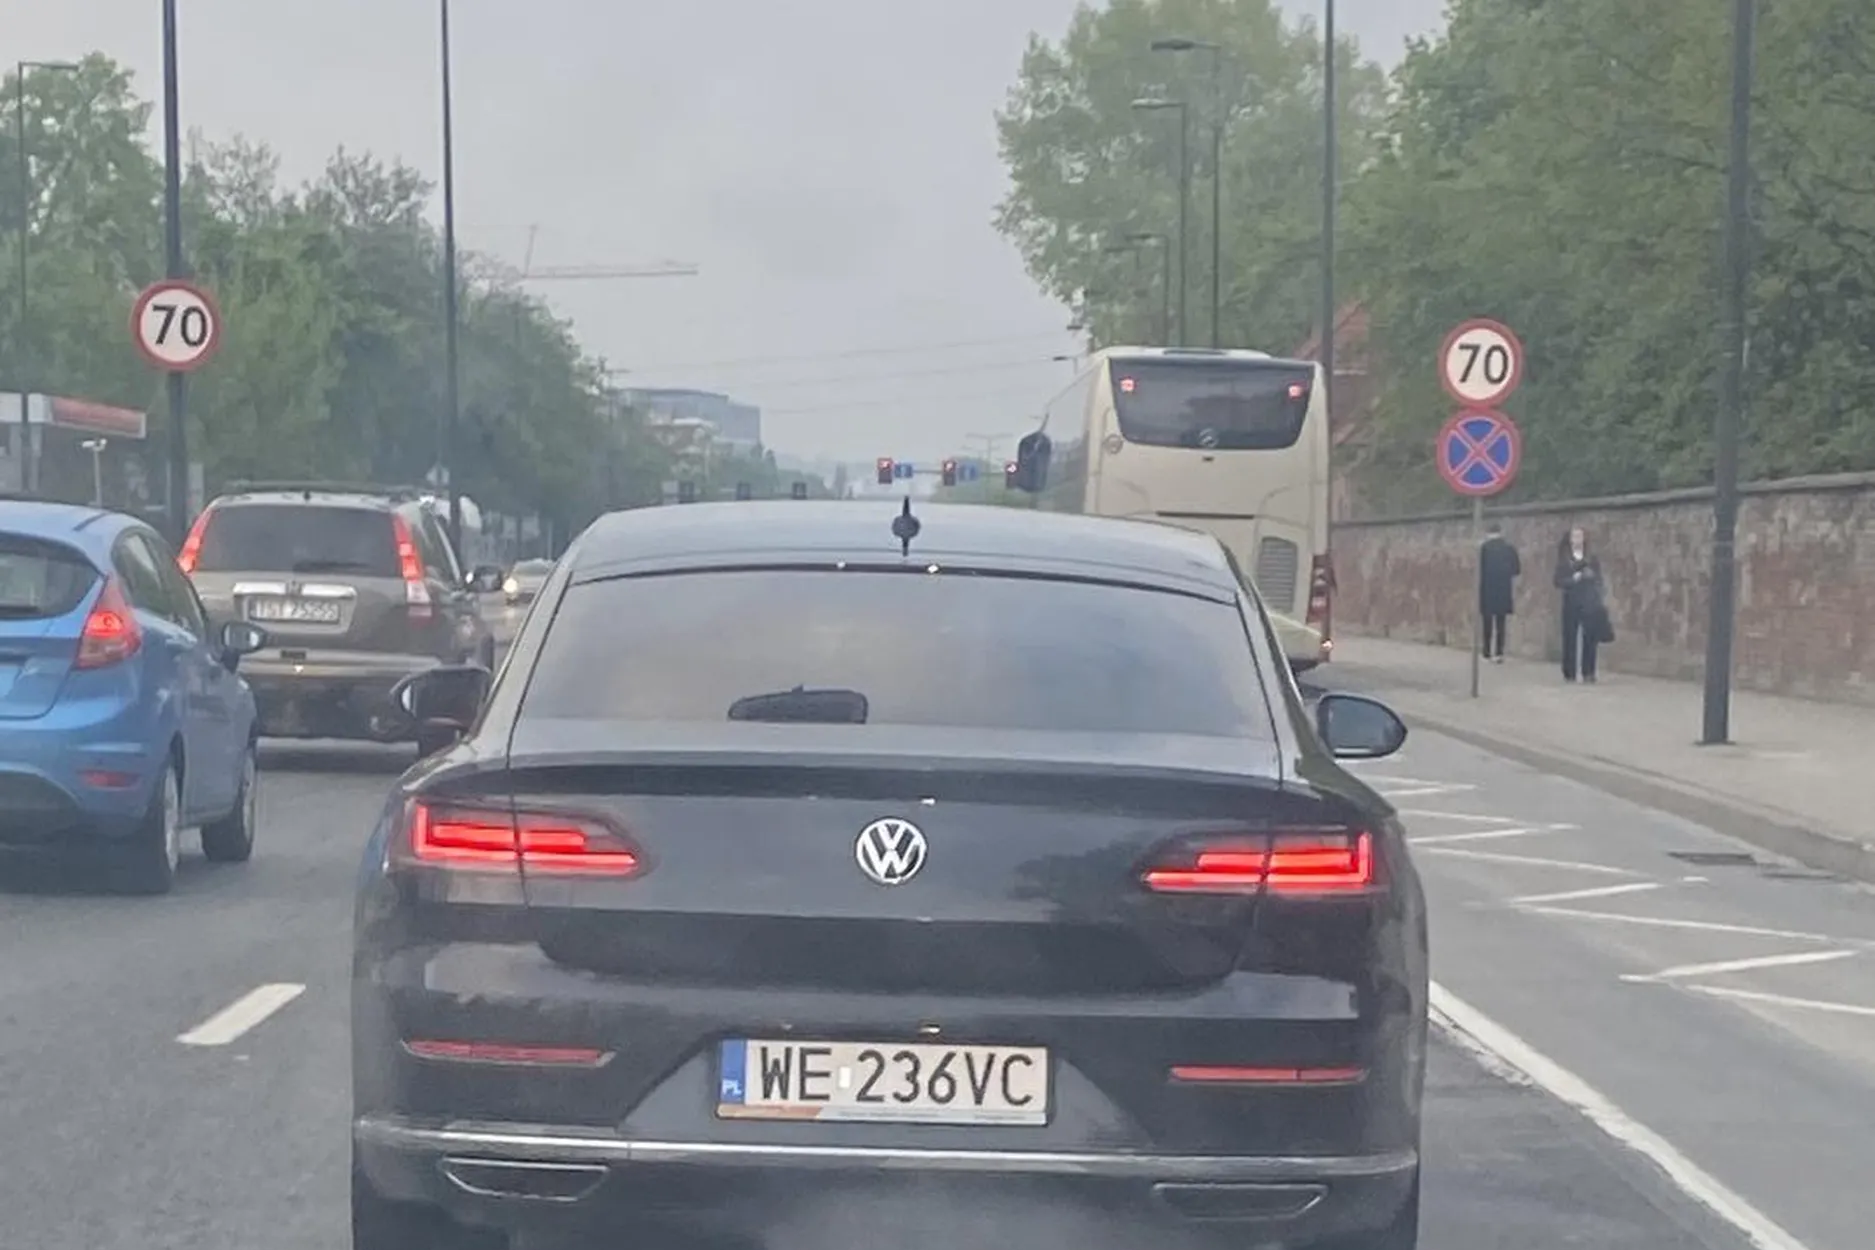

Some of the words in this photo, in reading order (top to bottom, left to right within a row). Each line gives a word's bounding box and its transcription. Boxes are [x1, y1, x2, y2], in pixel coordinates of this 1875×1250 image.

[152, 305, 208, 347] 70
[1458, 344, 1508, 384] 70
[856, 818, 927, 884] VW
[722, 1079, 742, 1096] PL
[761, 1046, 832, 1101] WE
[856, 1049, 1034, 1106] 236VC
